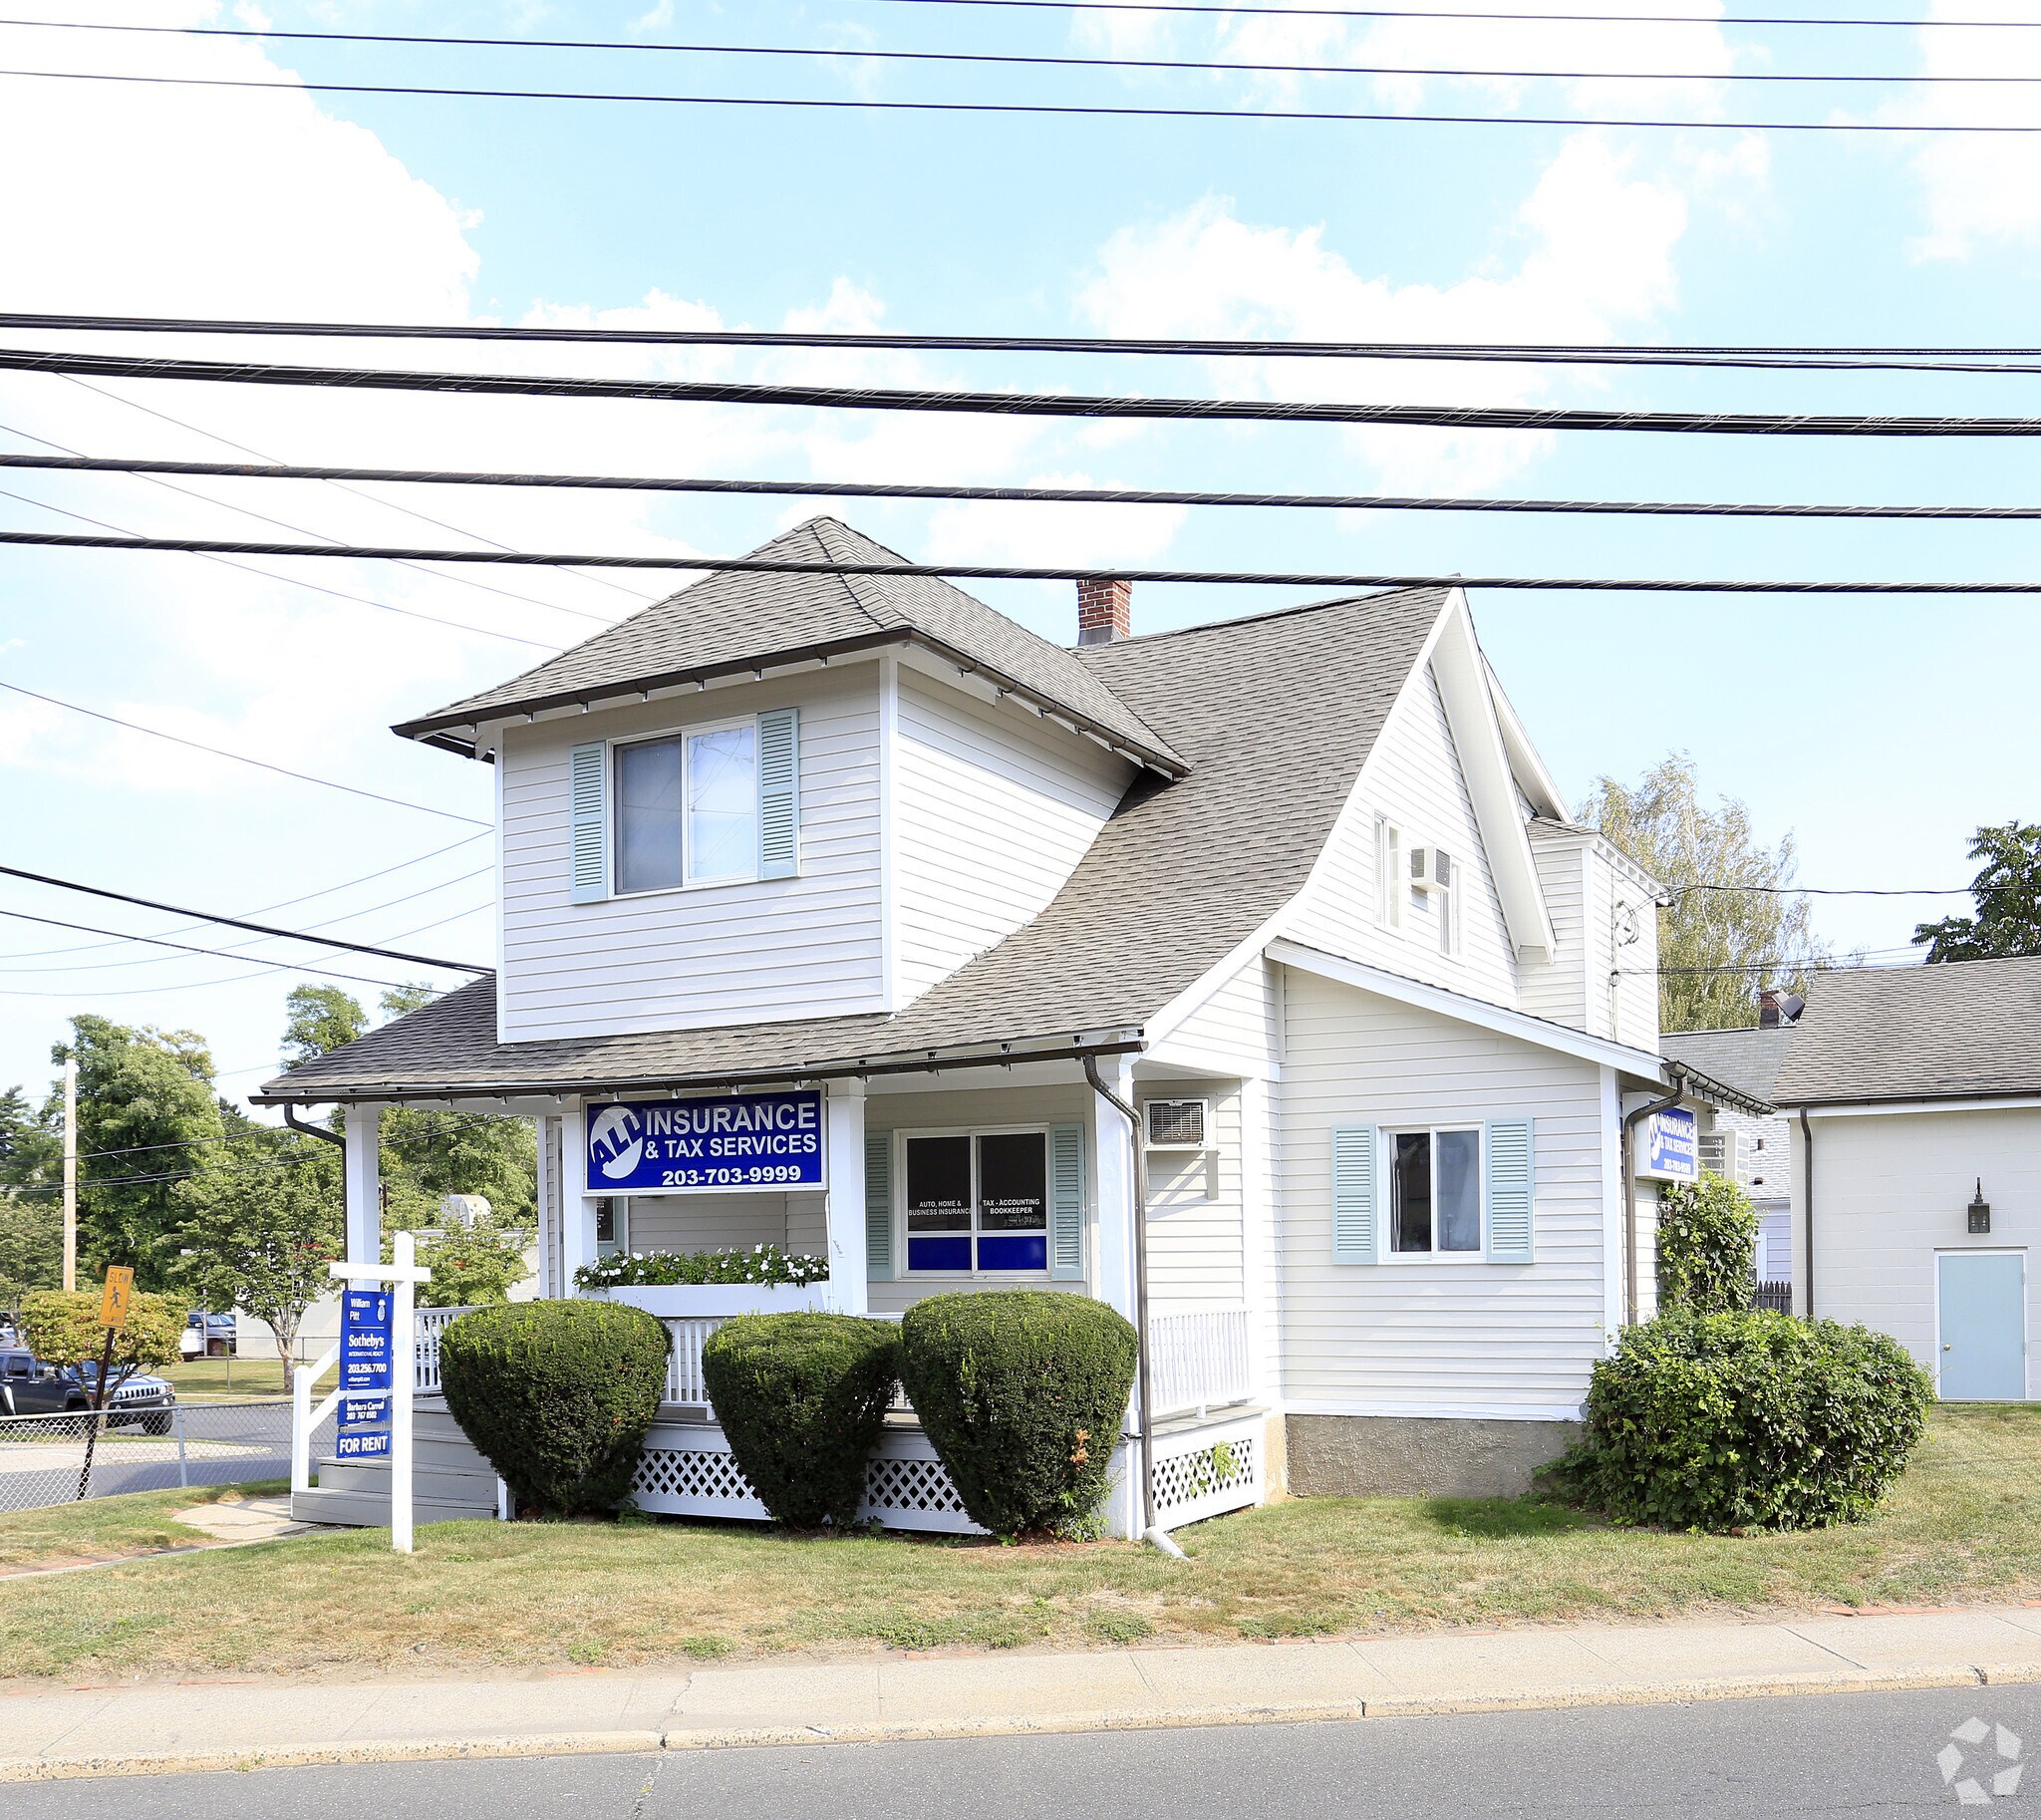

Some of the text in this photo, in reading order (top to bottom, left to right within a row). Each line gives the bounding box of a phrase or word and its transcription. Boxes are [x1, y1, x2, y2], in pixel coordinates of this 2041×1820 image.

[646, 1102, 816, 1136] INSURANCE
[1659, 1113, 1693, 1140] INSURANCE
[592, 1113, 642, 1172] ALL
[645, 1133, 817, 1159] & TAX SERVICES
[662, 1165, 801, 1186] 203-703-9999
[110, 1272, 130, 1284] SLOW
[350, 1298, 371, 1308] William
[349, 1311, 361, 1321] Pitt
[348, 1333, 385, 1350] Sotheby's
[347, 1364, 387, 1373] 203.256.7700
[347, 1402, 367, 1411] Barbara
[339, 1436, 388, 1453] FOR RENT
